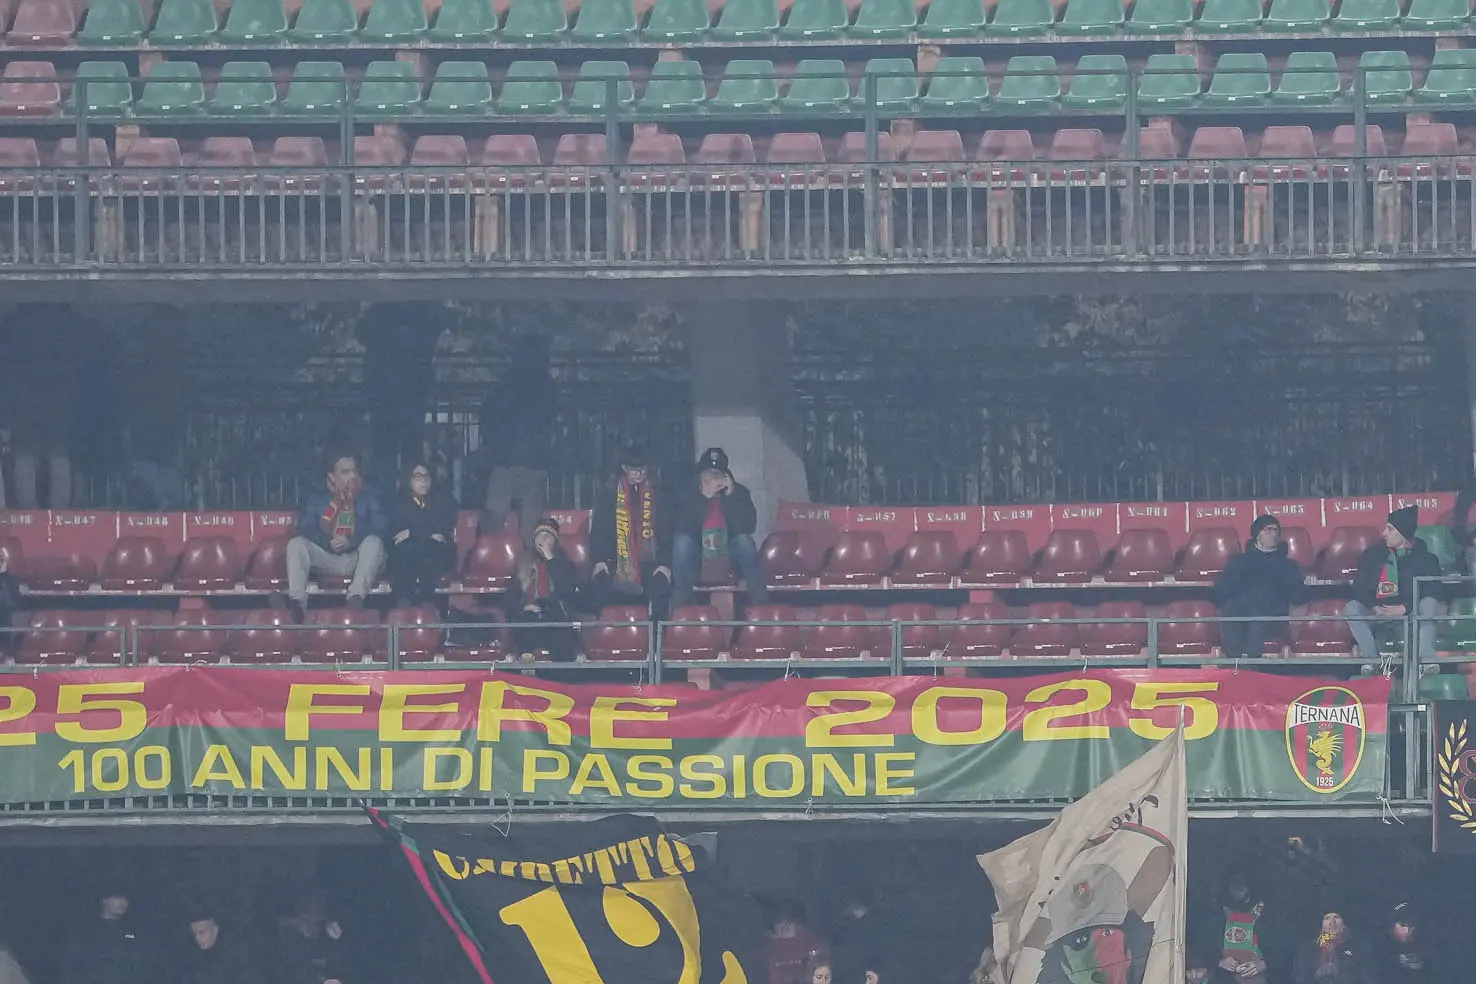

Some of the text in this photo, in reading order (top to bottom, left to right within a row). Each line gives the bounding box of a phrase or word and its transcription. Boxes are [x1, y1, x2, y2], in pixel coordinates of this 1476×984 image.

[284, 680, 678, 750] FERE
[805, 677, 1220, 748] 2025
[1294, 703, 1361, 727] TERNANA
[58, 744, 916, 800] 100 ANNI DI PASSIONE
[1316, 776, 1334, 787] 1925
